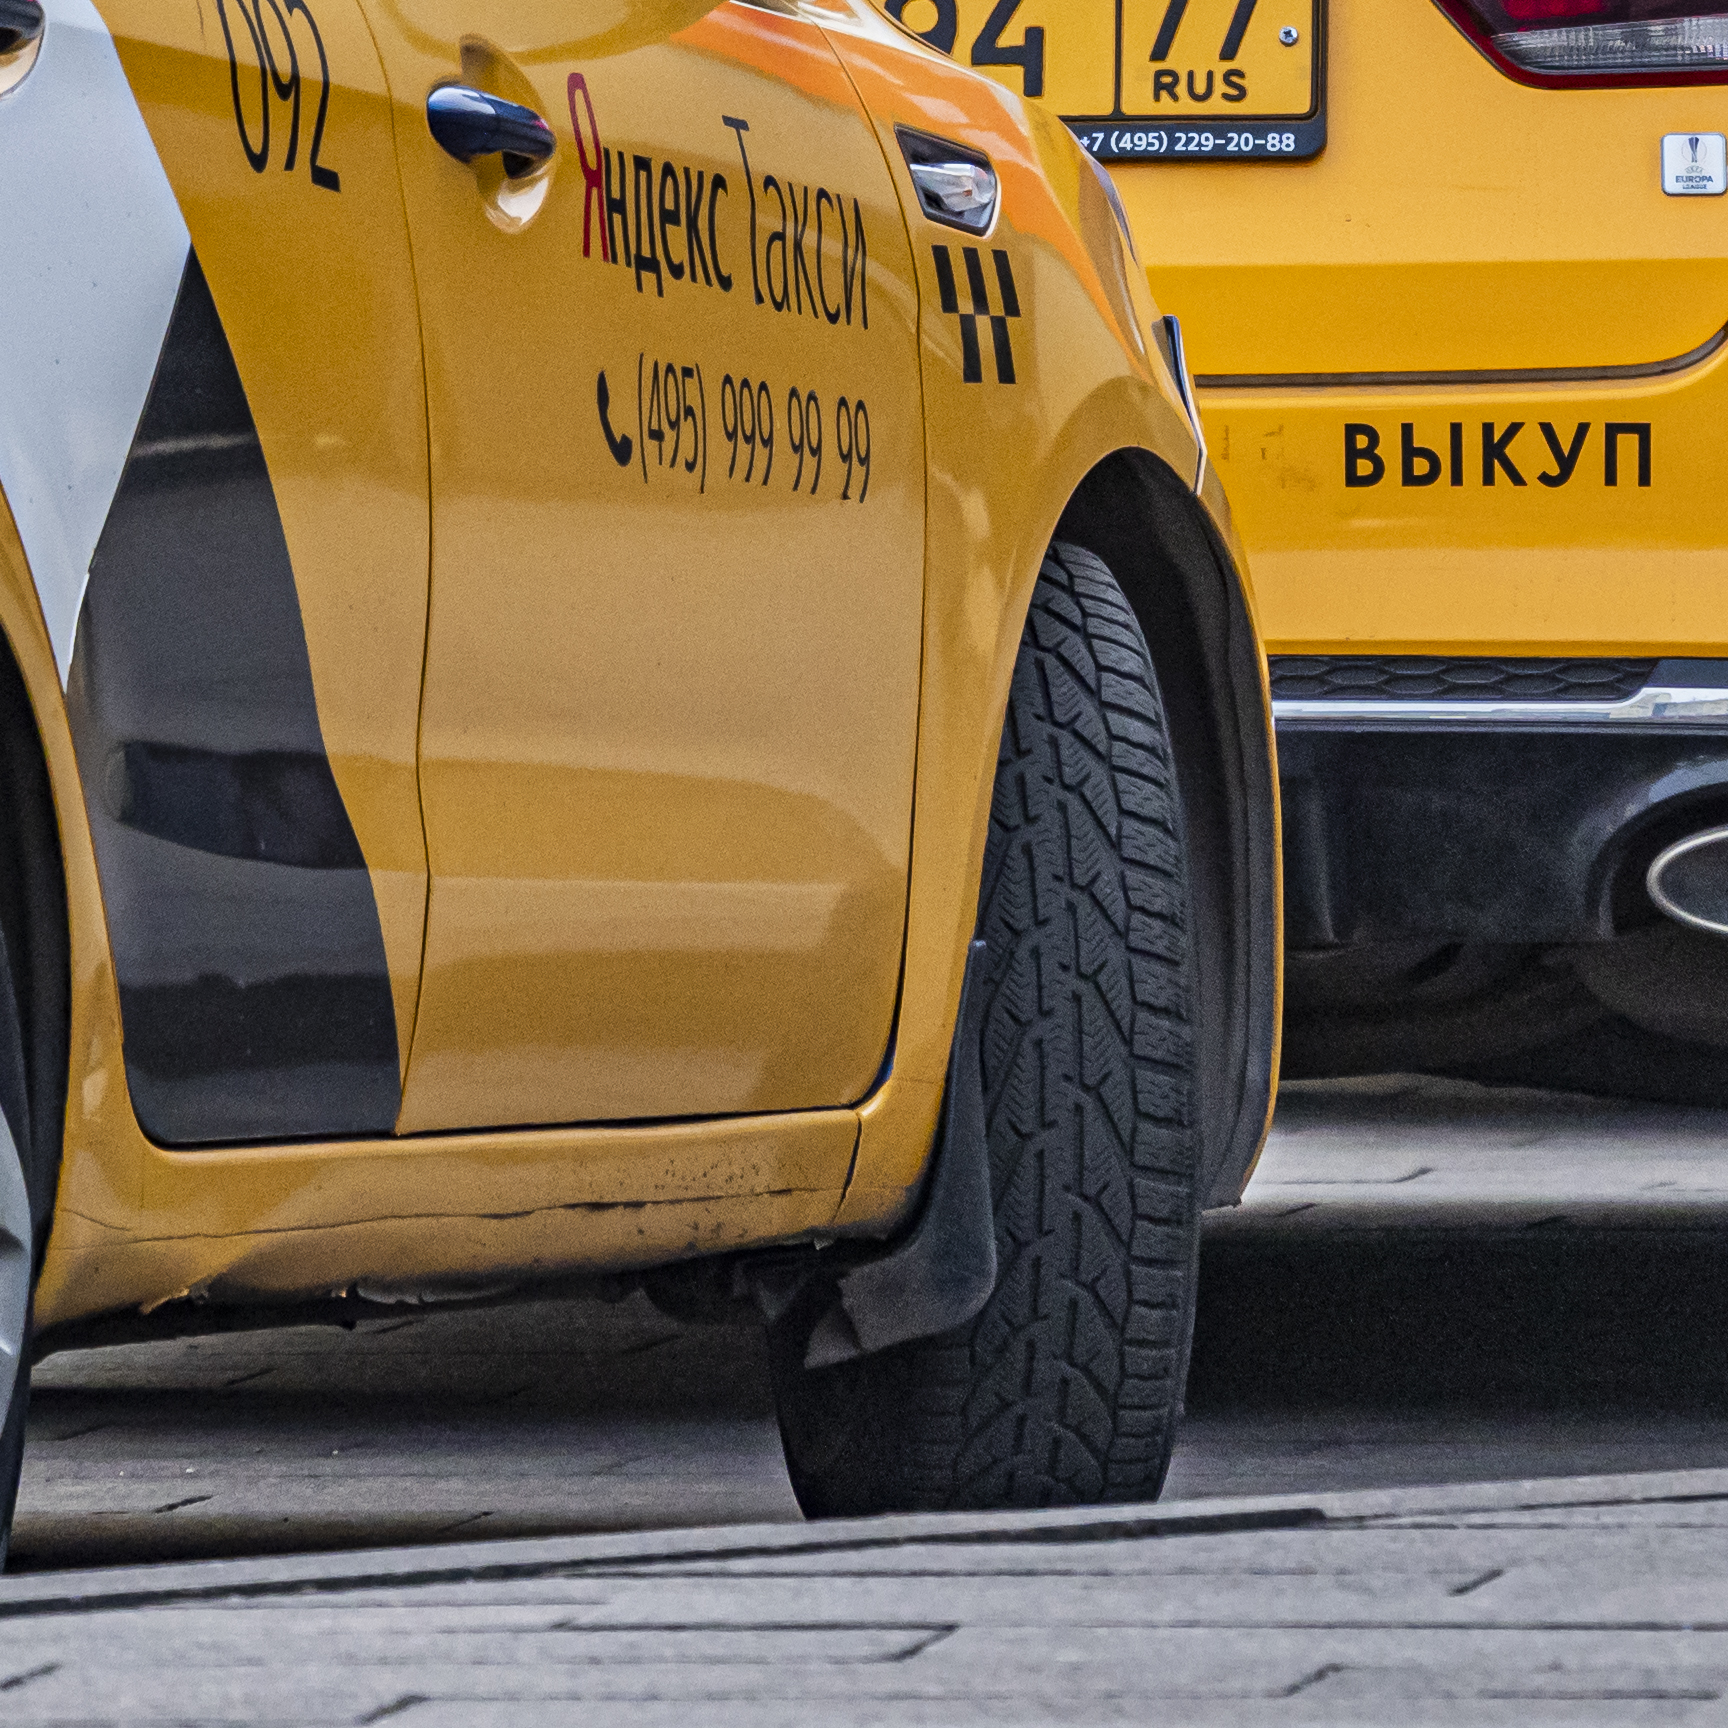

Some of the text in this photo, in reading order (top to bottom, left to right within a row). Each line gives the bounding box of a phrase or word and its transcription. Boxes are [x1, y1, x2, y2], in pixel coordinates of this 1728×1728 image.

[1152, 68, 1248, 103] RUS
[1110, 130, 1169, 153] (495)
[1174, 131, 1296, 153] 229-20-88
[566, 71, 869, 331] Яндекс Такси
[1675, 175, 1714, 183] EUROPA
[638, 352, 871, 504] (495) 999 99 99
[1343, 421, 1652, 488] ВЫКУП
